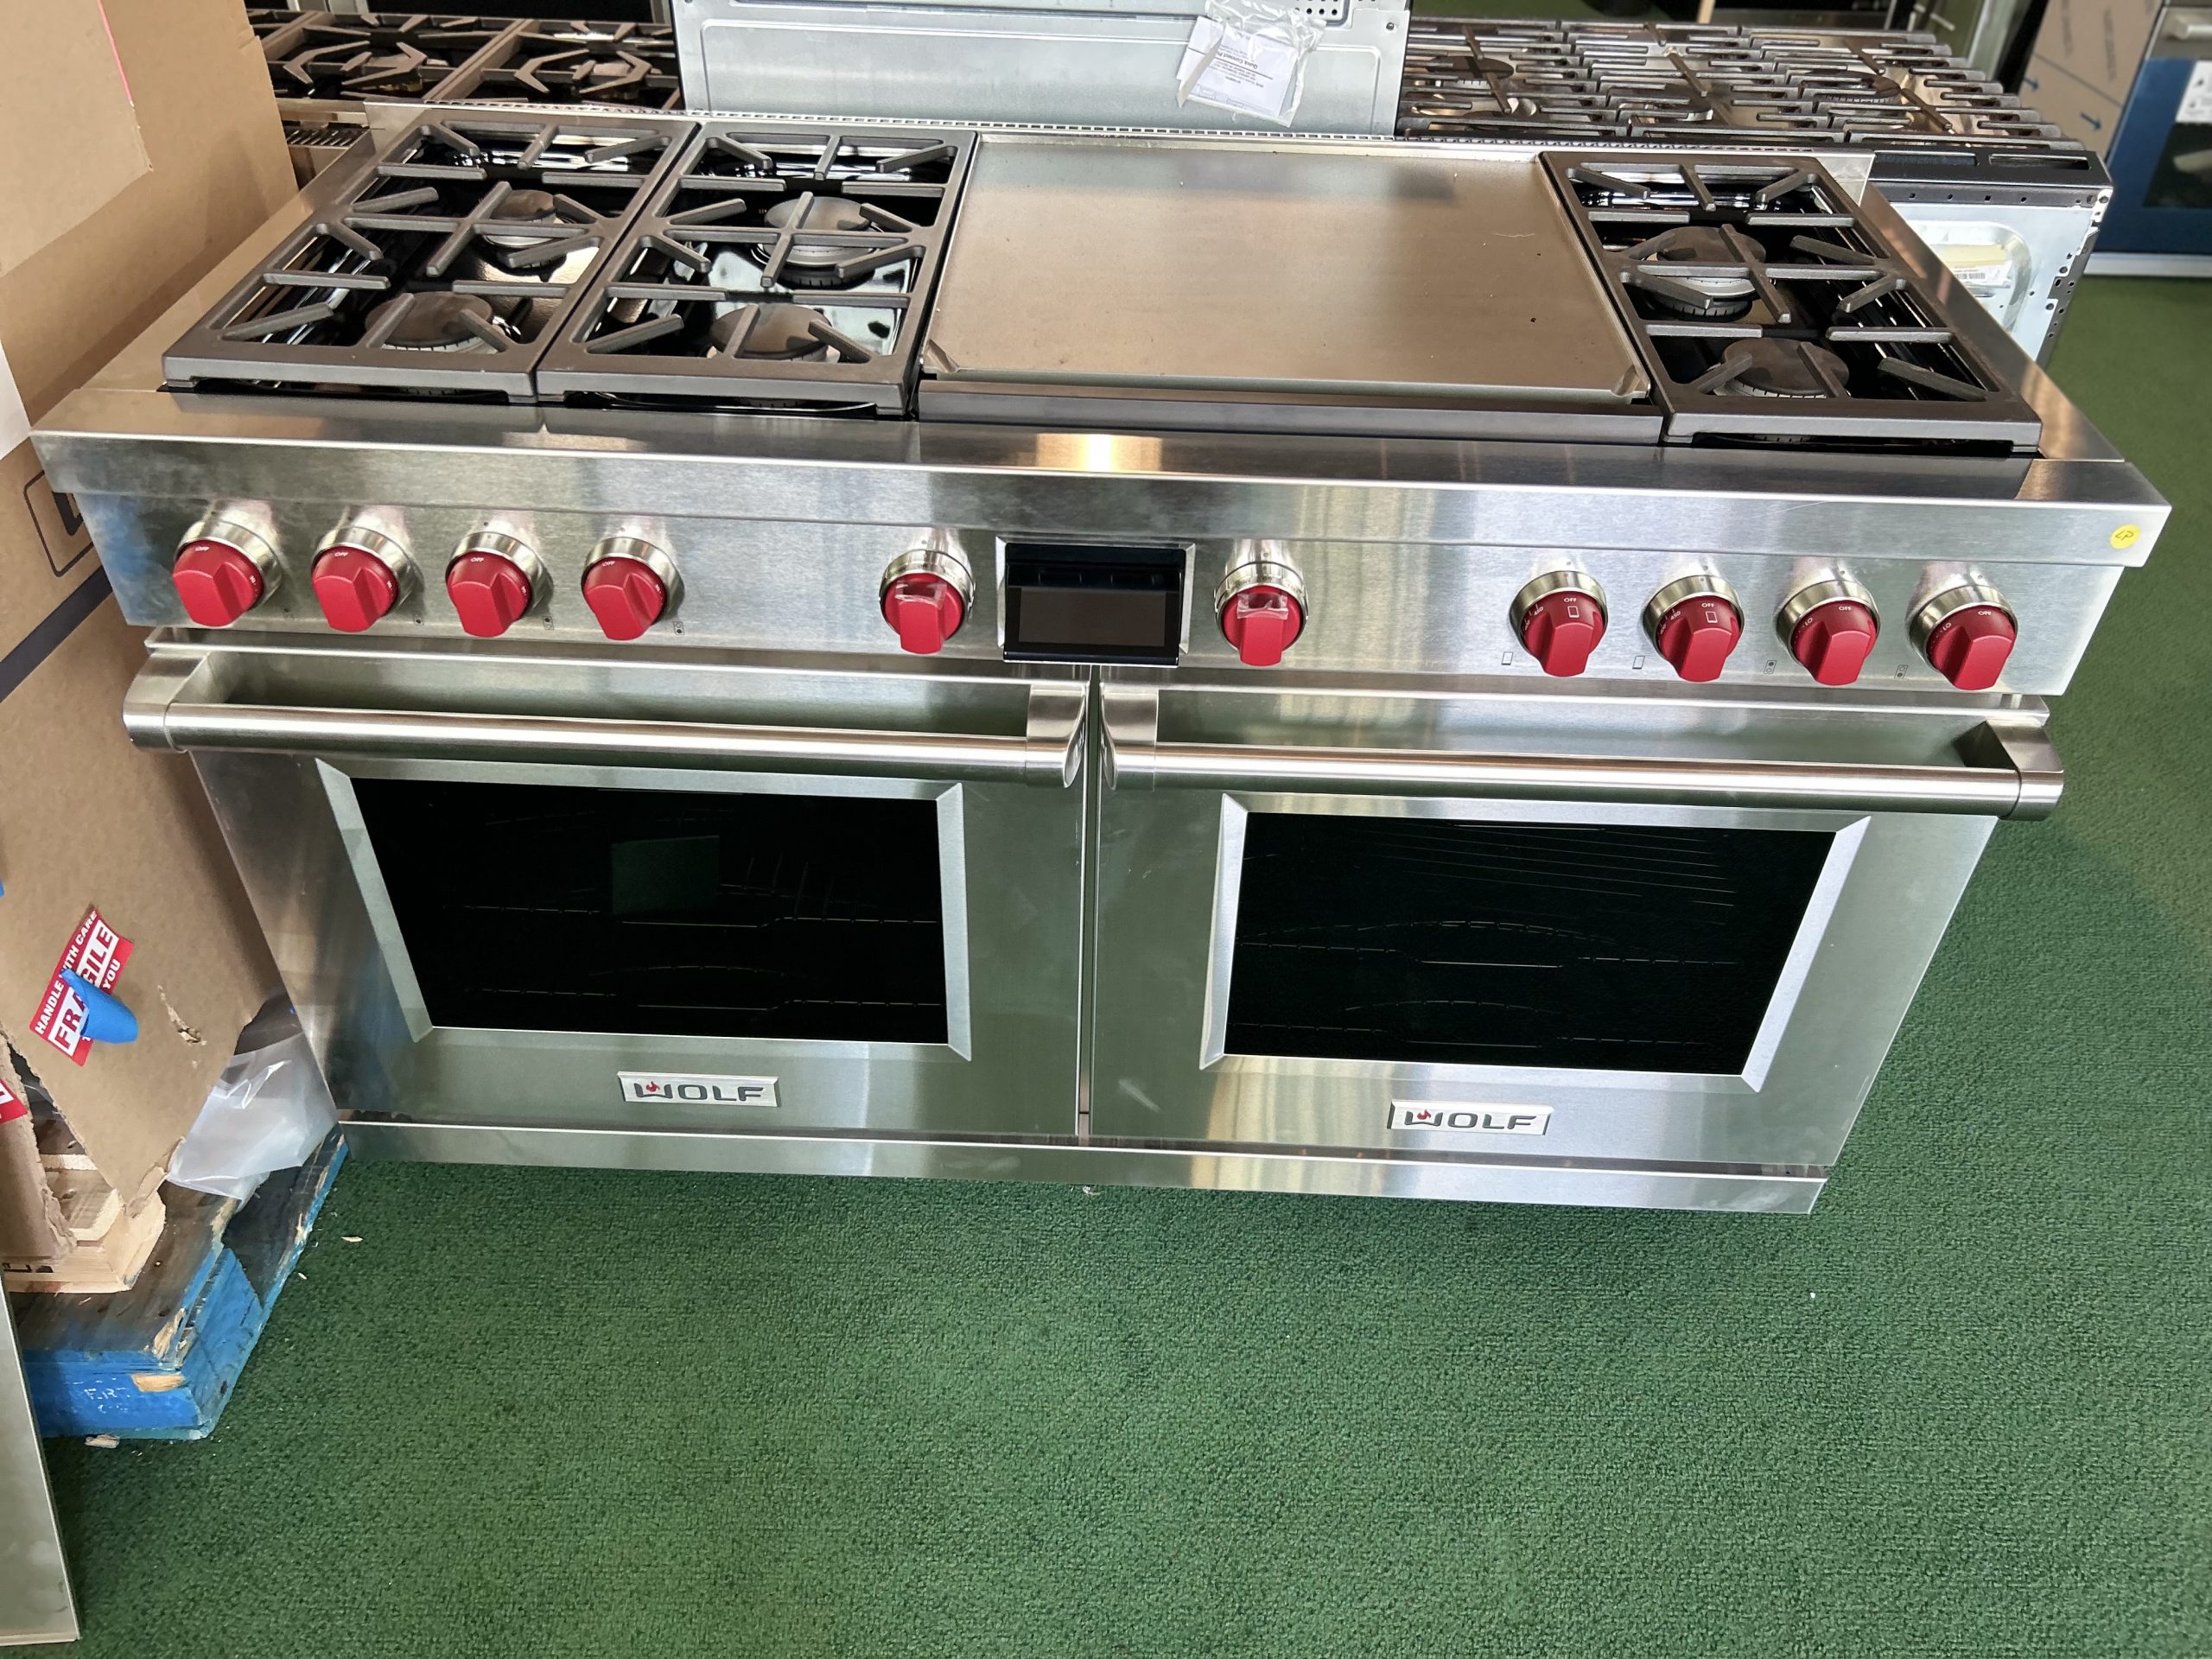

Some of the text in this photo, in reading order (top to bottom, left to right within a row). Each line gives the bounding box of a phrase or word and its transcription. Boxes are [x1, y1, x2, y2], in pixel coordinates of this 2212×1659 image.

[1670, 610, 1681, 620] 450
[1804, 617, 1814, 626] LO
[1942, 622, 1952, 631] LO
[35, 980, 65, 1035] HANDLE
[76, 910, 98, 945] CARE
[102, 958, 121, 990] YOU
[633, 1082, 764, 1102] WOLF
[1404, 1109, 1537, 1130] WOLF
